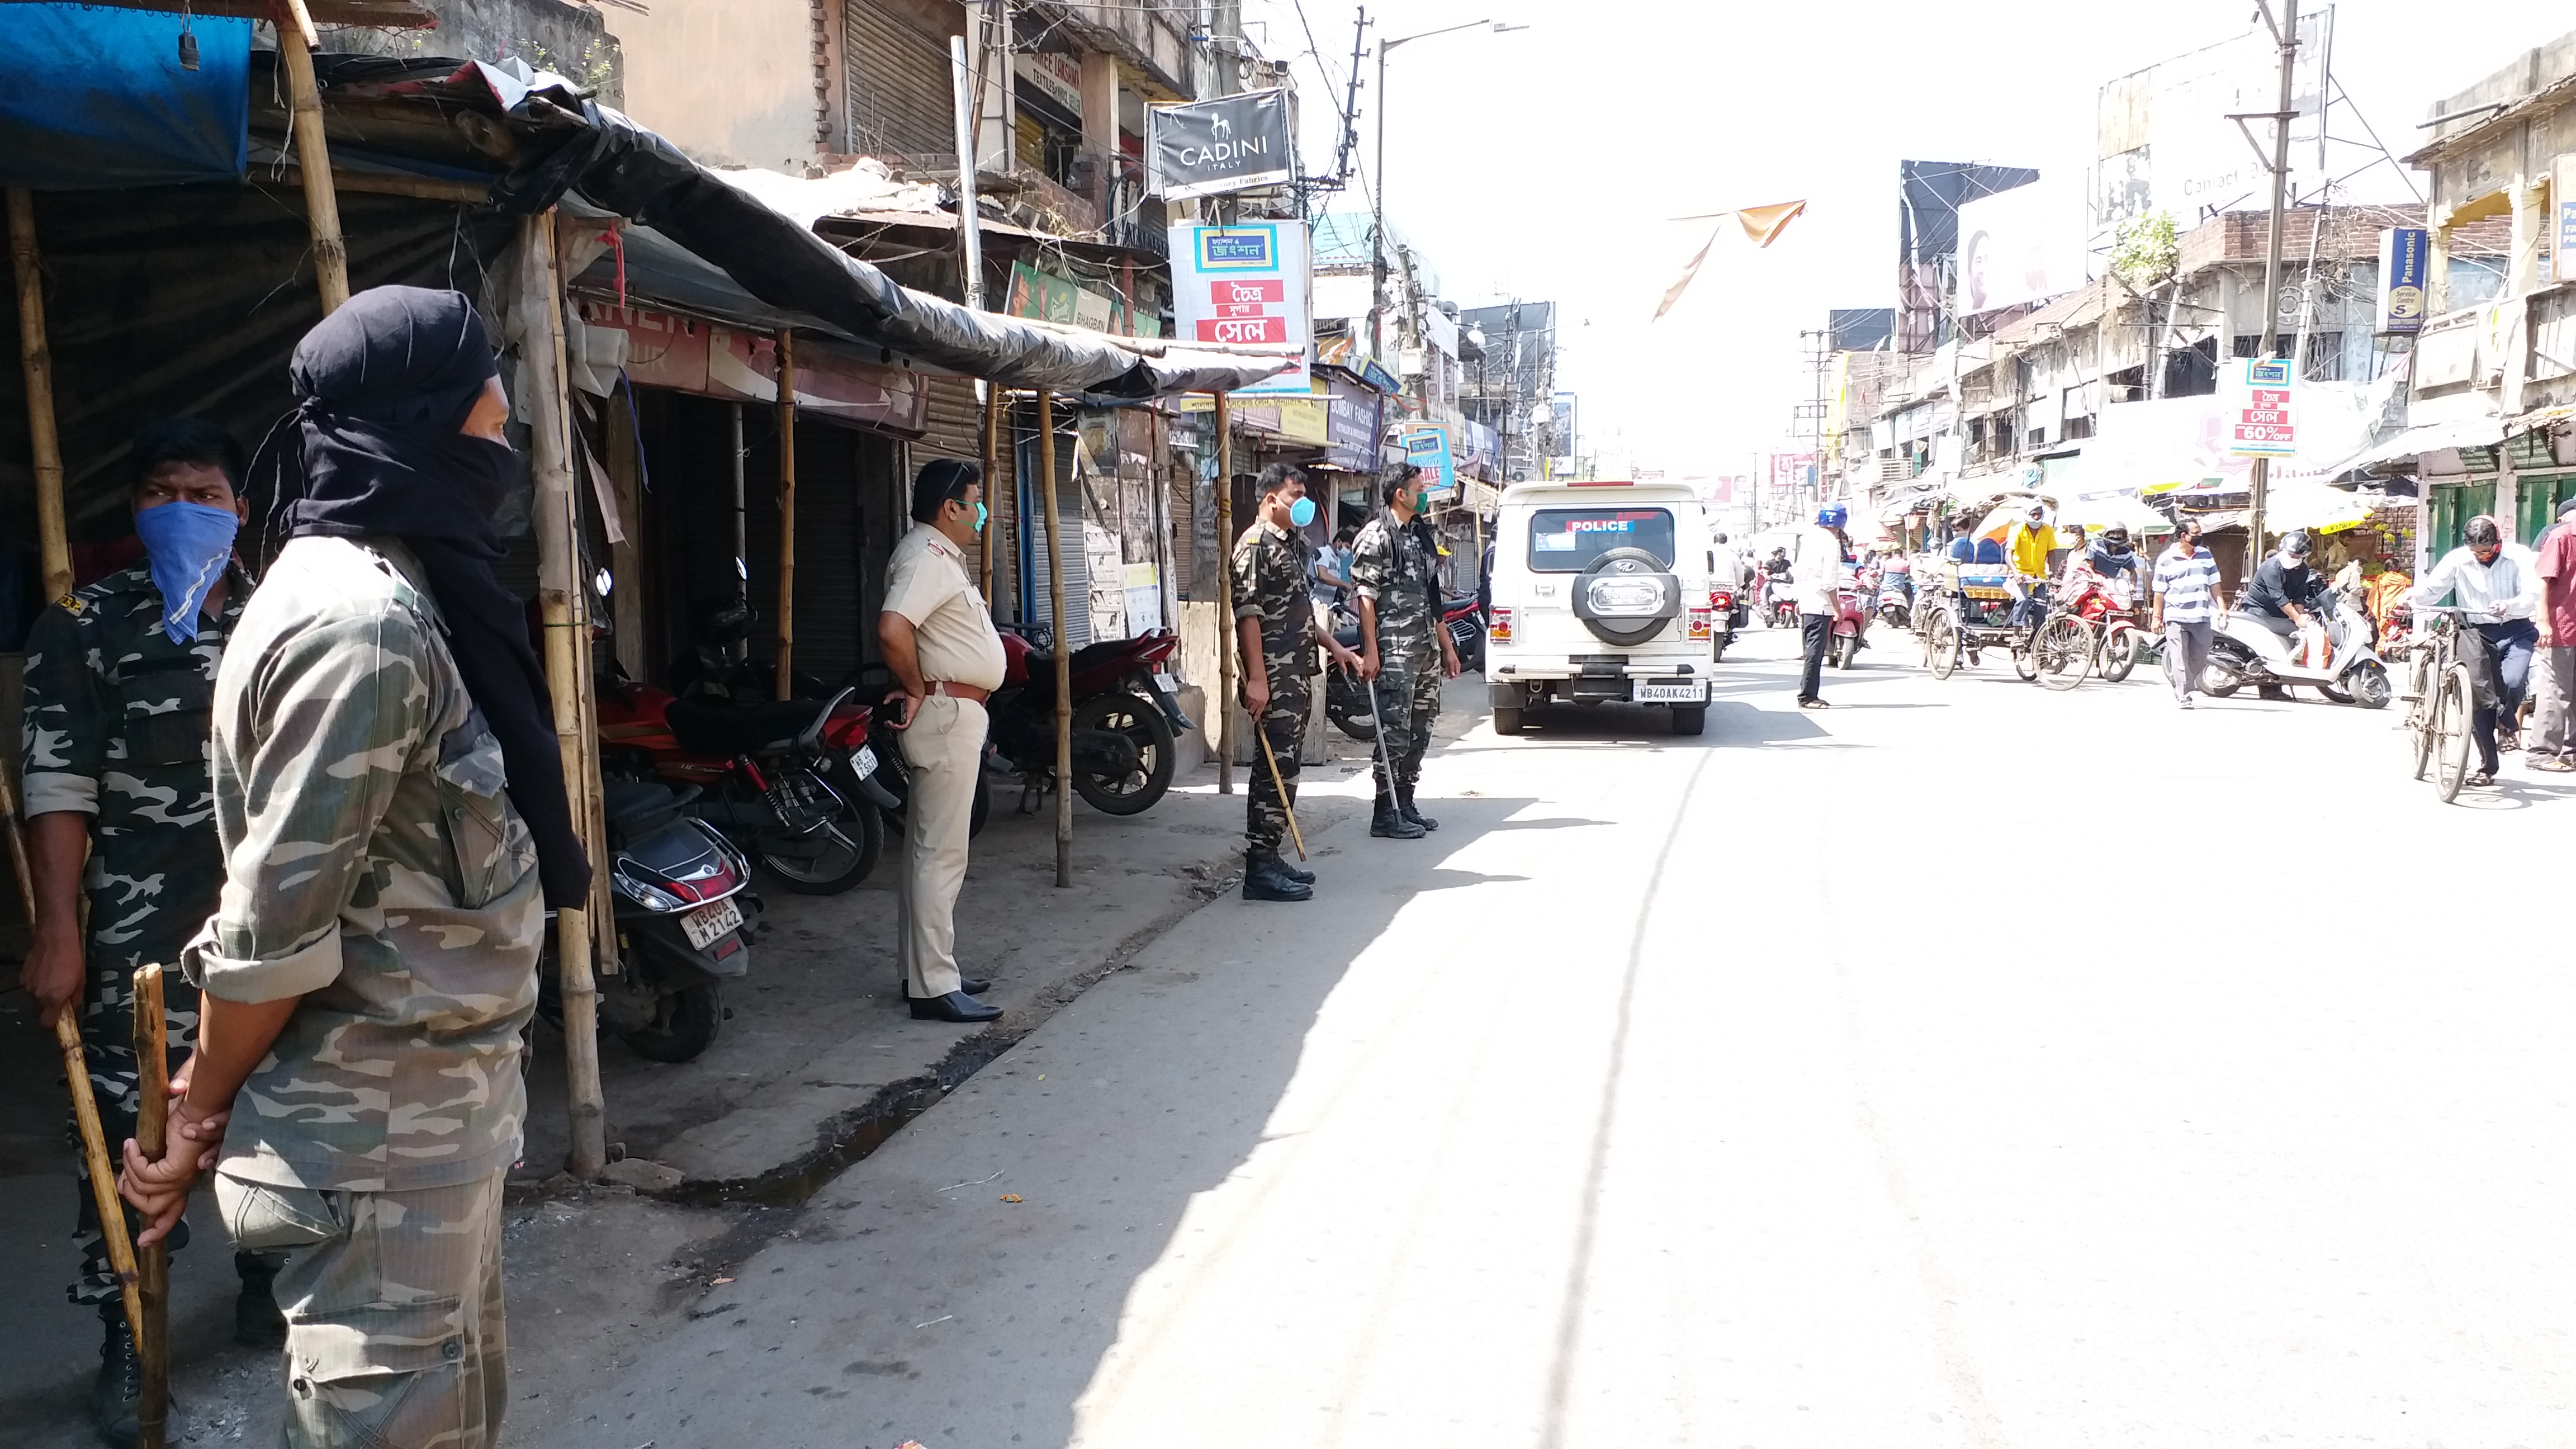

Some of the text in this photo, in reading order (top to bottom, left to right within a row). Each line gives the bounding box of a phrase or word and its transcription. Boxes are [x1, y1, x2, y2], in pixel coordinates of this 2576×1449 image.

[1180, 135, 1267, 166] CADINI
[1207, 160, 1242, 172] ITALY
[1239, 176, 1268, 185] Fabrics
[2184, 168, 2238, 196] Conact
[2402, 231, 2416, 283] Panasonic
[1231, 281, 1265, 302] চৈত্র
[1077, 311, 1106, 333] BHAGBAN
[1215, 319, 1268, 342] সেল
[1331, 400, 1353, 420] BOMBAY
[2251, 410, 2280, 423] সেল
[2243, 426, 2279, 440] 60%
[1572, 520, 1628, 532] POLICE
[1641, 688, 1703, 698] WB40AK4211
[709, 910, 740, 937] 2142
